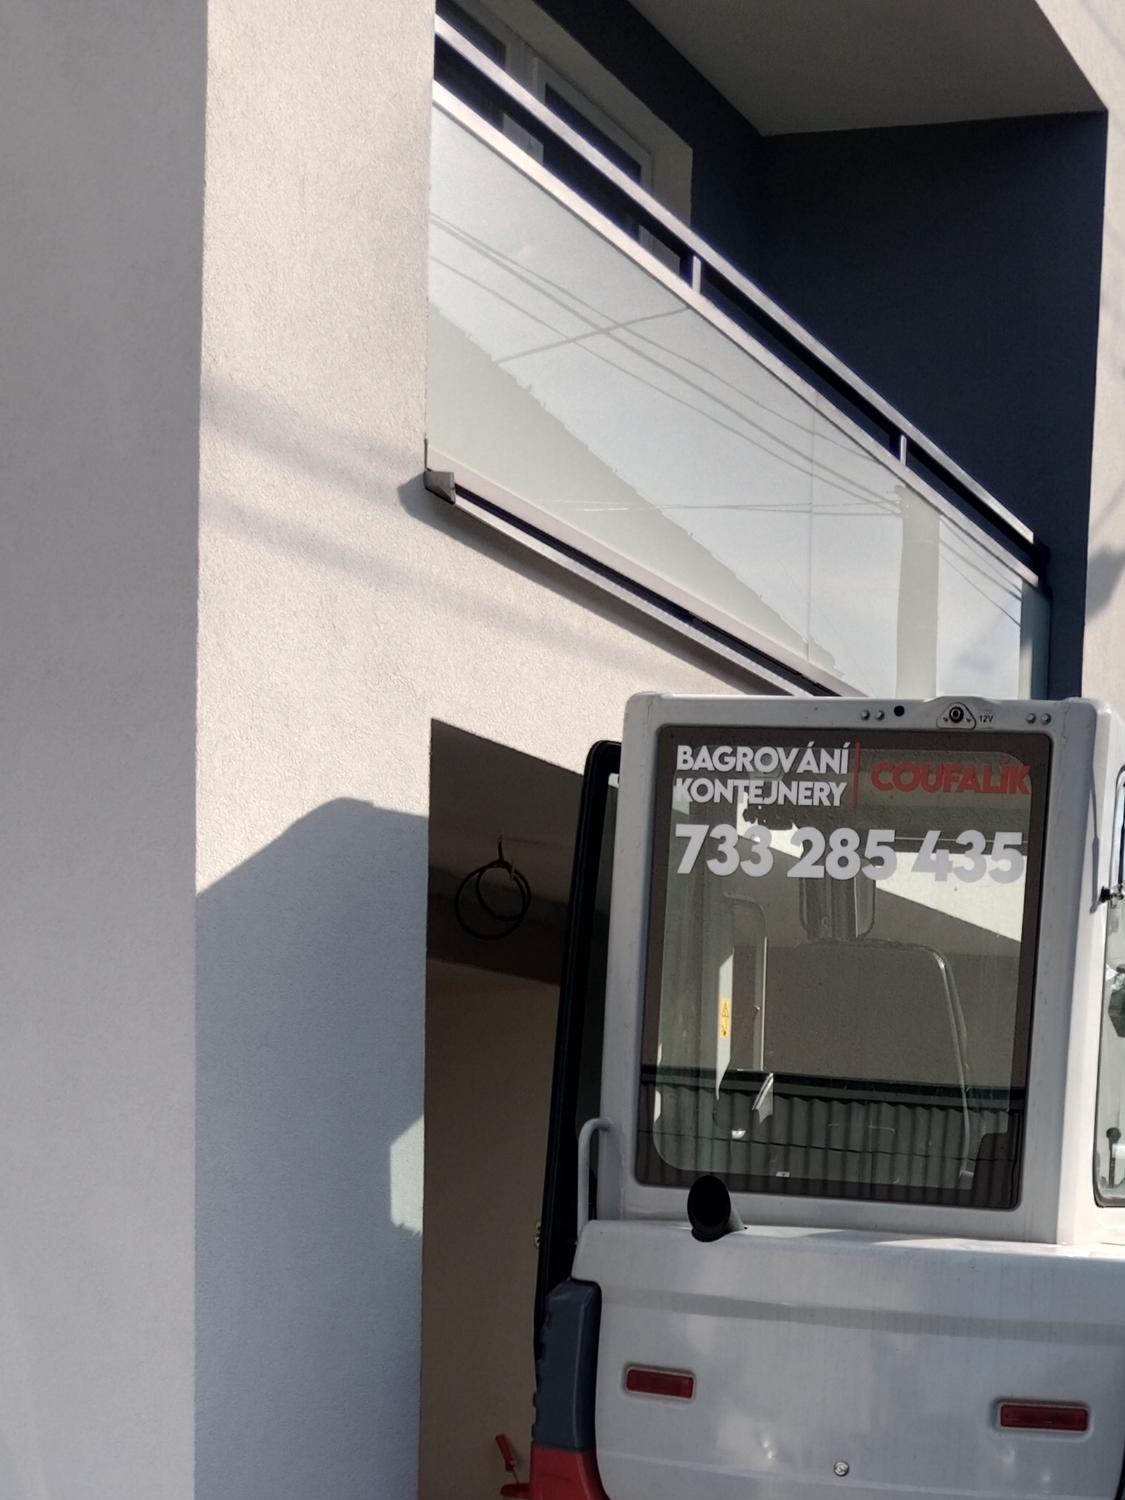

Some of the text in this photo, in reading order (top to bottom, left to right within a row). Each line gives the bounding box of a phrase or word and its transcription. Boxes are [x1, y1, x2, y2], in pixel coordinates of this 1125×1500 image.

[979, 714, 994, 723] 12V
[675, 741, 850, 775] BAGROVÁNÍ
[675, 778, 848, 807] KONTEJNERY
[675, 823, 1024, 884] 733 285 435
